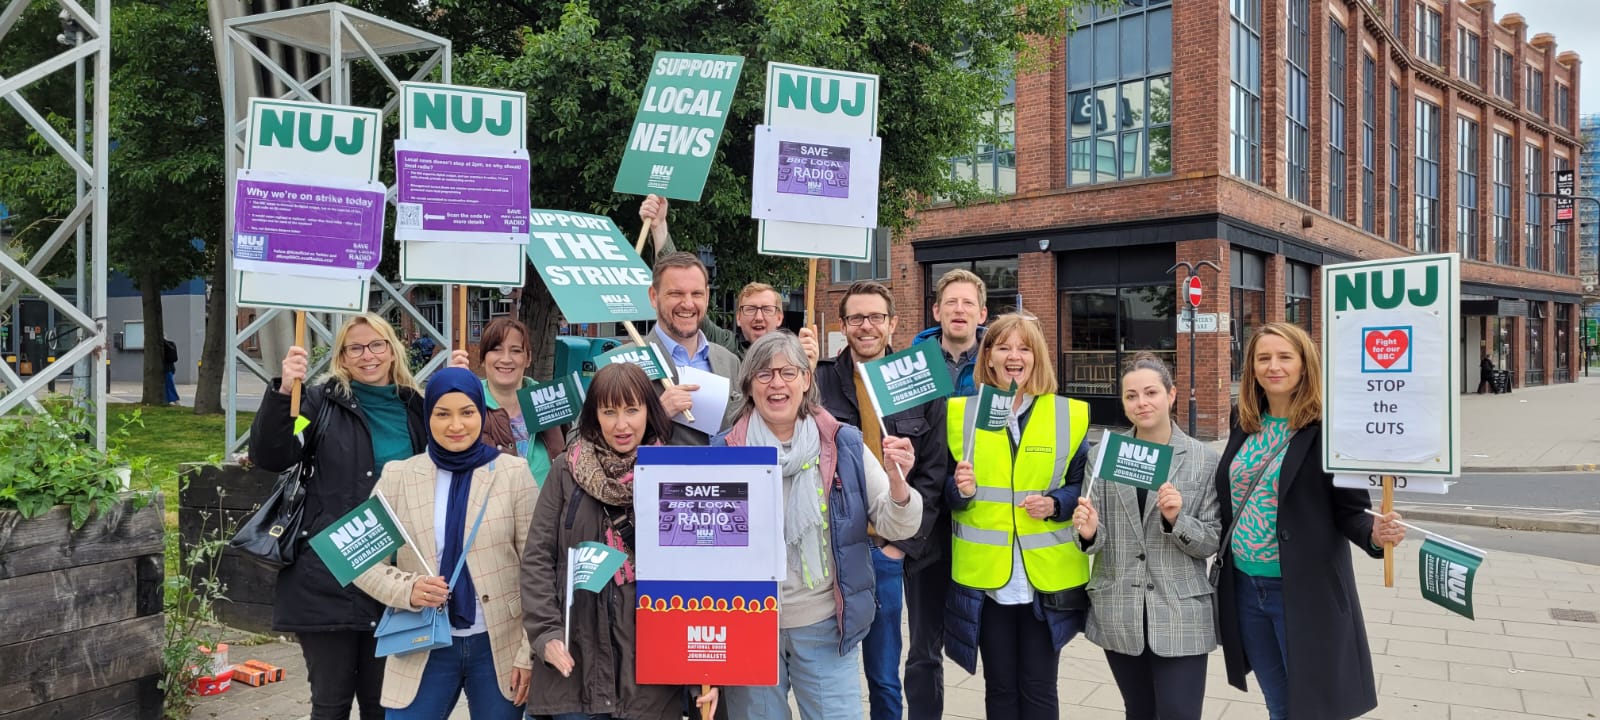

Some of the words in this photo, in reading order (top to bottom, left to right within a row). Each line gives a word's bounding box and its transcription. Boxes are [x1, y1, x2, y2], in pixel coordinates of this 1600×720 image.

[655, 58, 737, 80] SUPPORT
[643, 86, 722, 118] LOCAL
[778, 73, 866, 116] NUJ
[414, 92, 512, 136] NUJ
[259, 108, 366, 155] NUJ
[630, 122, 715, 157] NEWS
[801, 146, 828, 156] SAVE
[651, 165, 674, 175] NUJ
[811, 159, 843, 168] LOCAL
[794, 167, 834, 180] RADIO
[247, 187, 268, 199] Why
[272, 190, 297, 199] we're
[316, 192, 342, 203] strike
[346, 197, 373, 208] today
[530, 212, 611, 231] UPPORT
[238, 235, 264, 246] NUJ
[533, 232, 628, 261] THE
[546, 266, 652, 285] STRIKE
[1334, 265, 1439, 312] NUJ
[600, 295, 631, 304] NUJ
[1376, 338, 1397, 346] Fight
[610, 350, 650, 363] NUJ
[880, 351, 927, 382] NUJ
[888, 377, 912, 390] NATIONAL
[914, 371, 931, 381] UNION
[1367, 380, 1405, 392] STOP
[530, 383, 565, 405] NUJ
[893, 383, 935, 402] JOURNALISTS
[991, 394, 1011, 409] NU
[535, 403, 555, 412] NATIONAL
[539, 408, 572, 422] JOURNALISTS
[1374, 400, 1398, 413] the
[1366, 422, 1404, 435] CUTS
[1118, 442, 1159, 464] NUJ
[1117, 460, 1139, 468] NATIONAL
[1114, 468, 1152, 481] JOURNALISTS
[685, 485, 720, 496] SAVE
[678, 513, 728, 525] RADIO
[329, 508, 378, 550] NUJ
[343, 538, 368, 556] NATIONAL
[369, 526, 384, 539] UNION
[351, 536, 392, 567] JOURNALISTS
[1448, 562, 1468, 606] NUJ
[688, 626, 726, 642] NUJ
